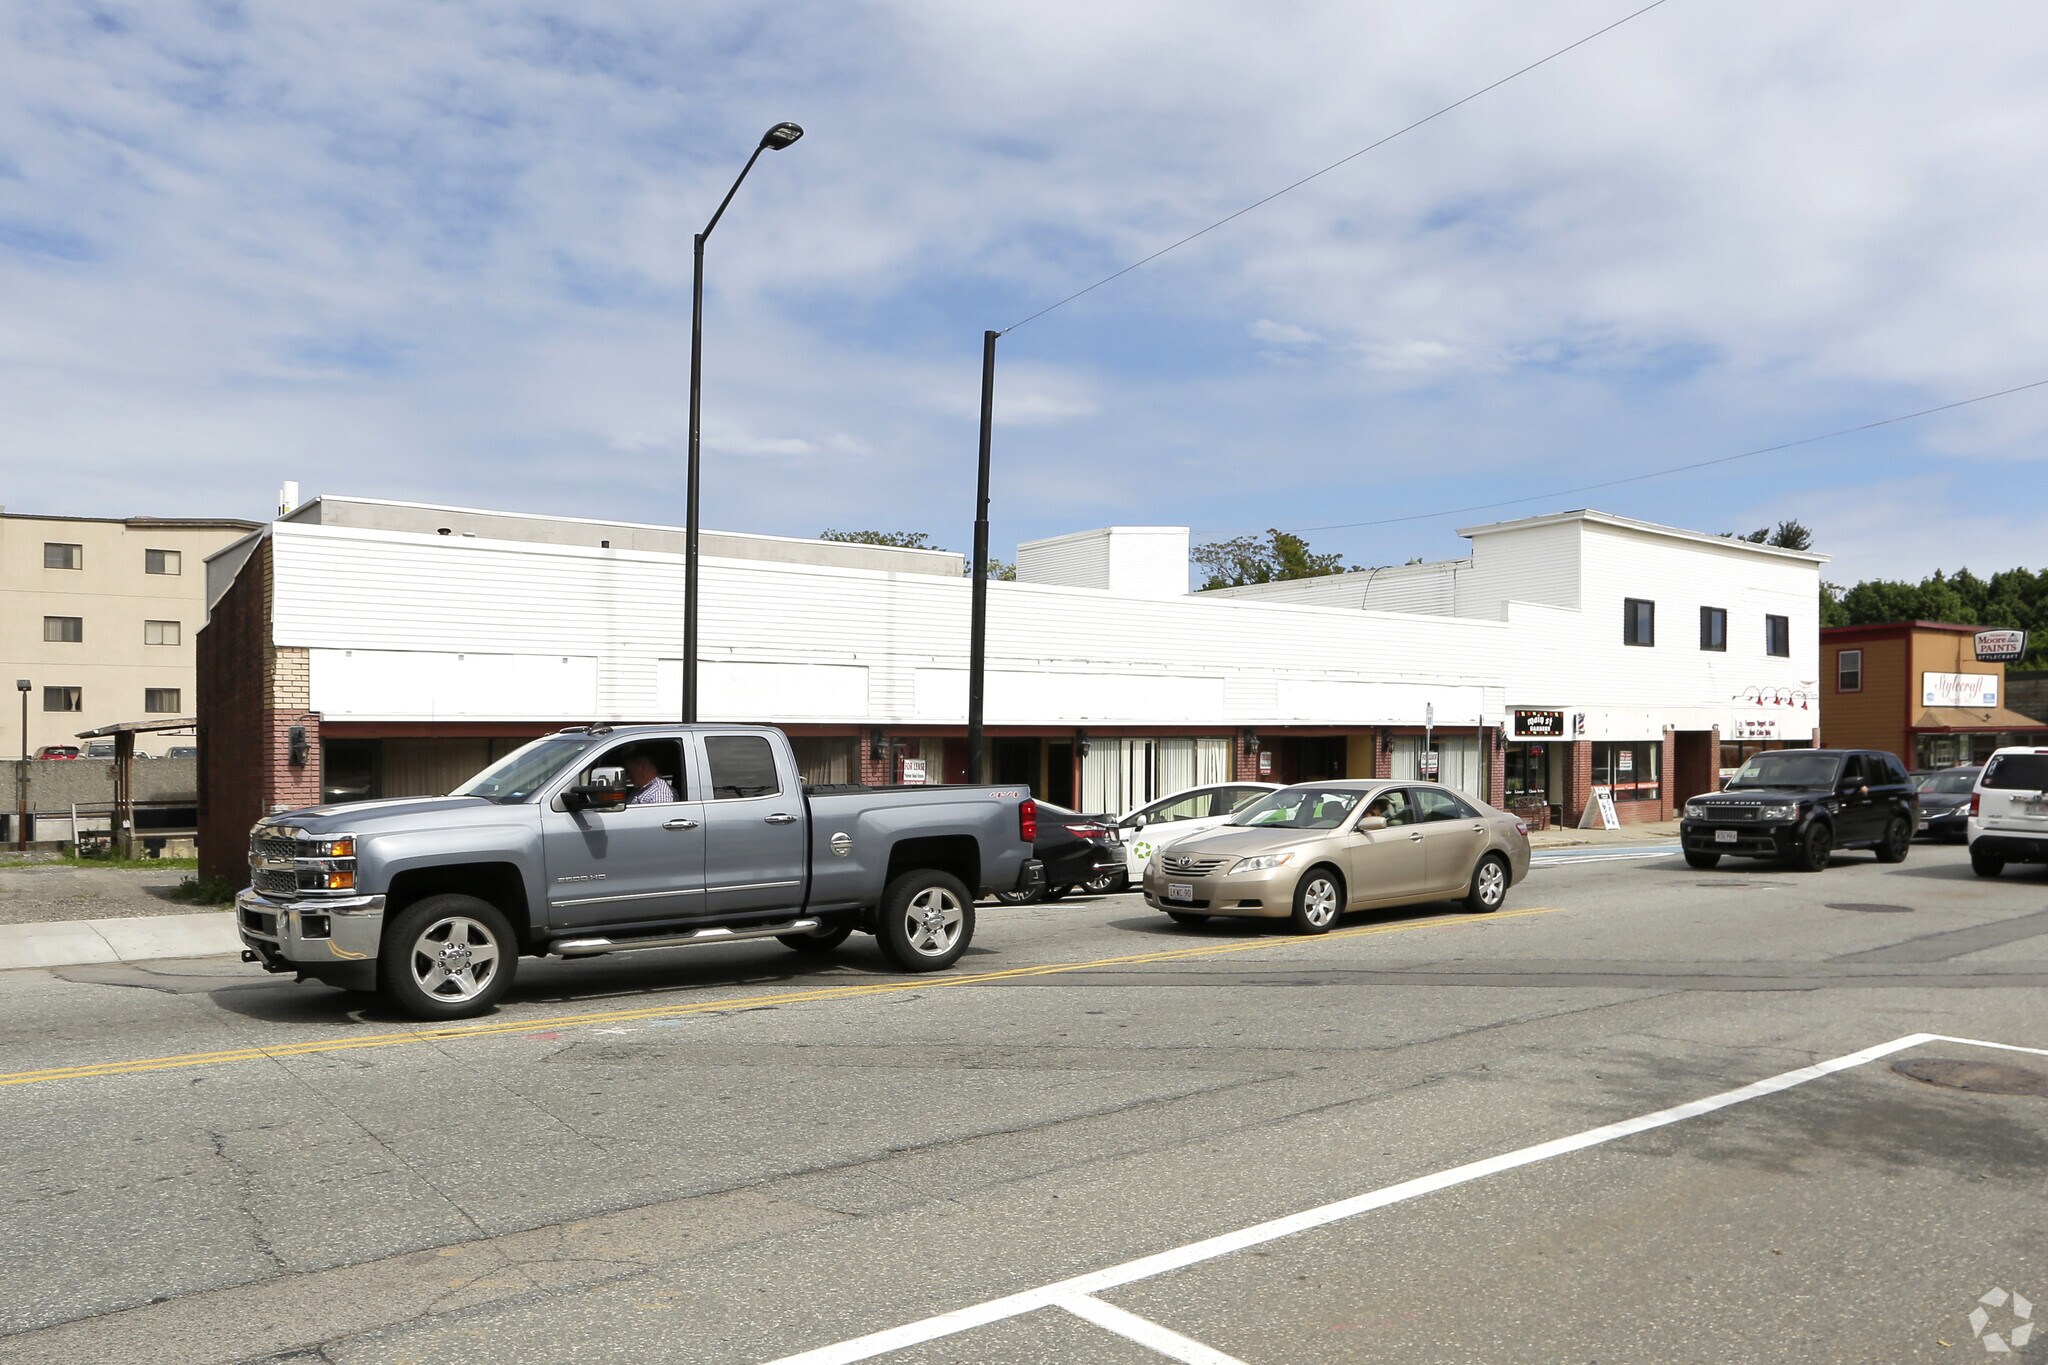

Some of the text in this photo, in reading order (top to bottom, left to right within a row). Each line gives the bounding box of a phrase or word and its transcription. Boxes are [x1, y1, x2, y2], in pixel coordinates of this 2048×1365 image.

[1978, 636, 2006, 644] Moore
[1980, 643, 2017, 652] PAINTS
[1935, 675, 1983, 698] Stylecraft
[904, 761, 925, 771] FOR LEASE
